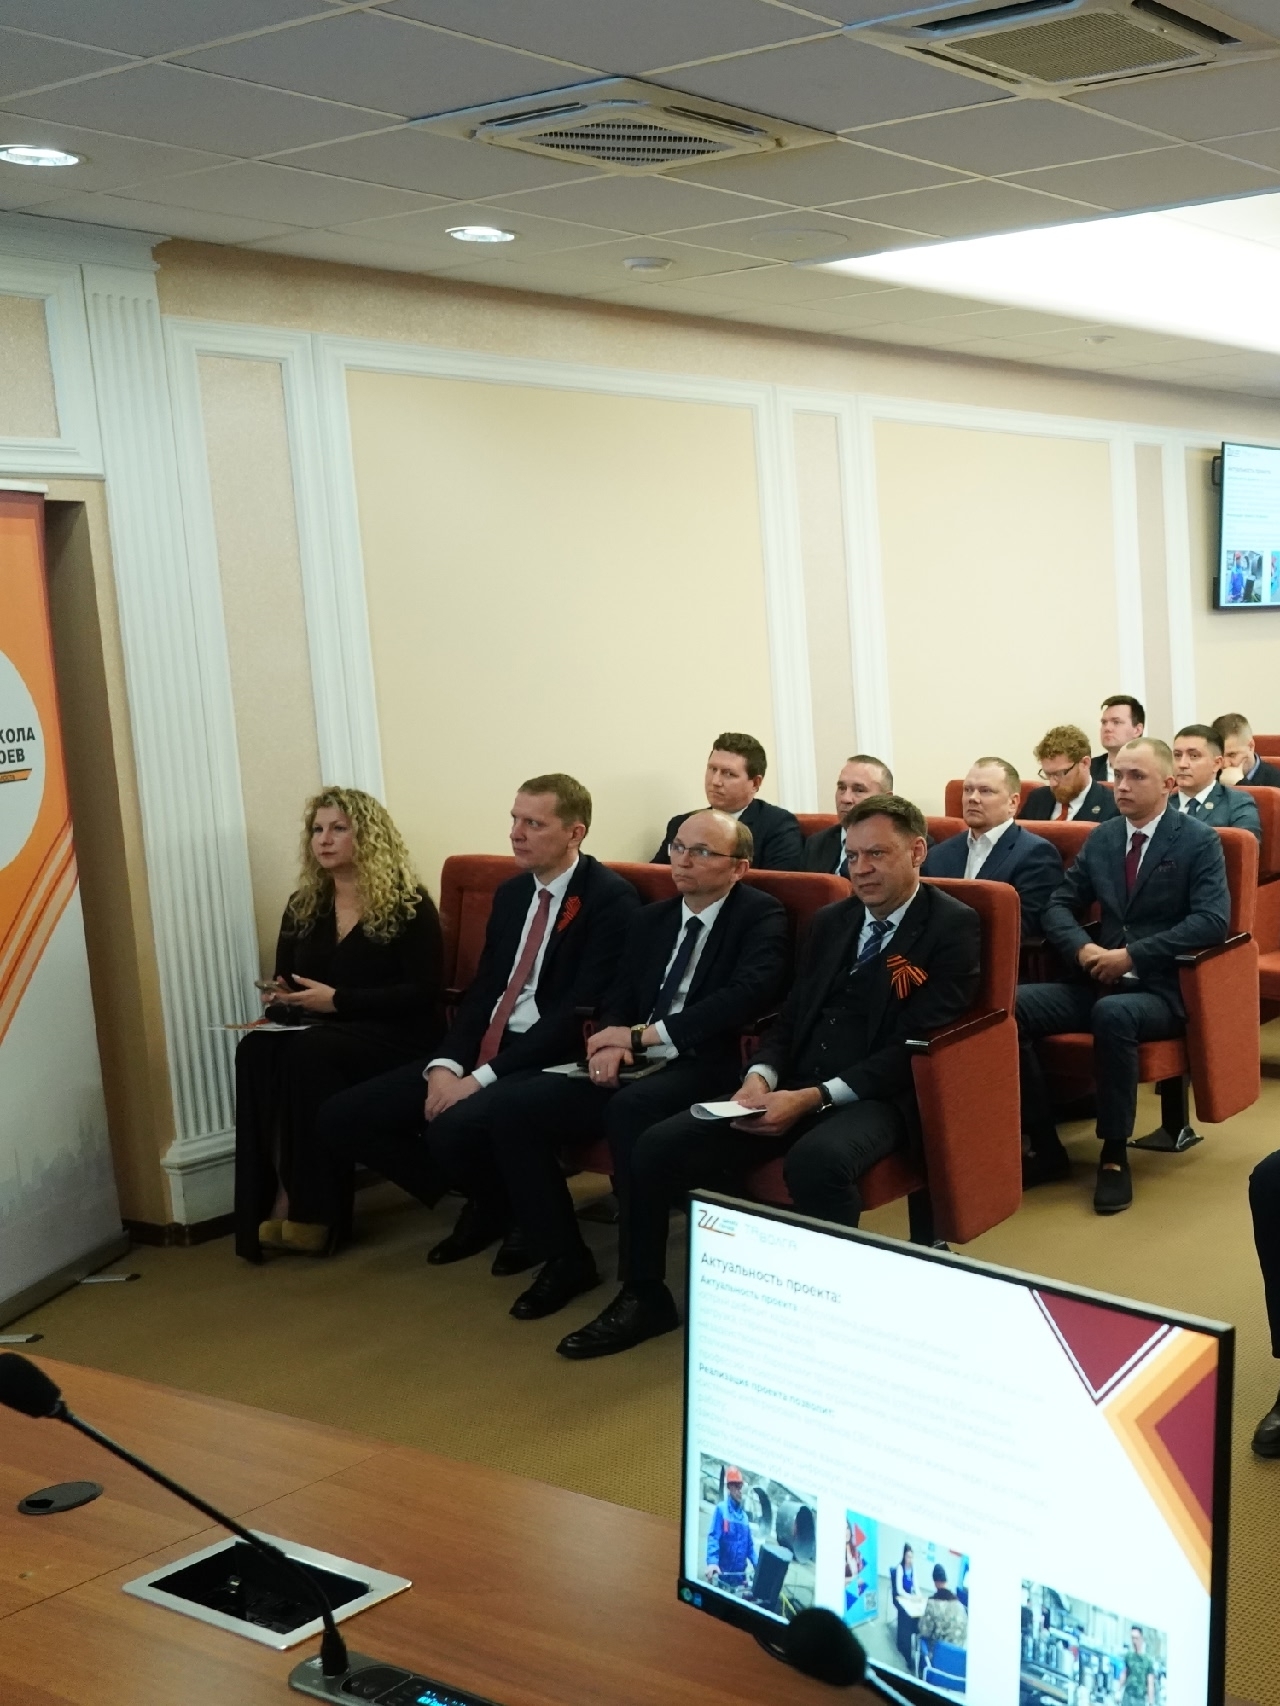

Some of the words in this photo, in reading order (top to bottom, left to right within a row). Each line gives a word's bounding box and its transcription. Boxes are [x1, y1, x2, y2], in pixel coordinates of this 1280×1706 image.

[700, 1275, 760, 1300] Актуальность
[701, 1252, 783, 1286] Актуальность
[786, 1278, 842, 1304] проекта:
[699, 1362, 750, 1388] Реализация
